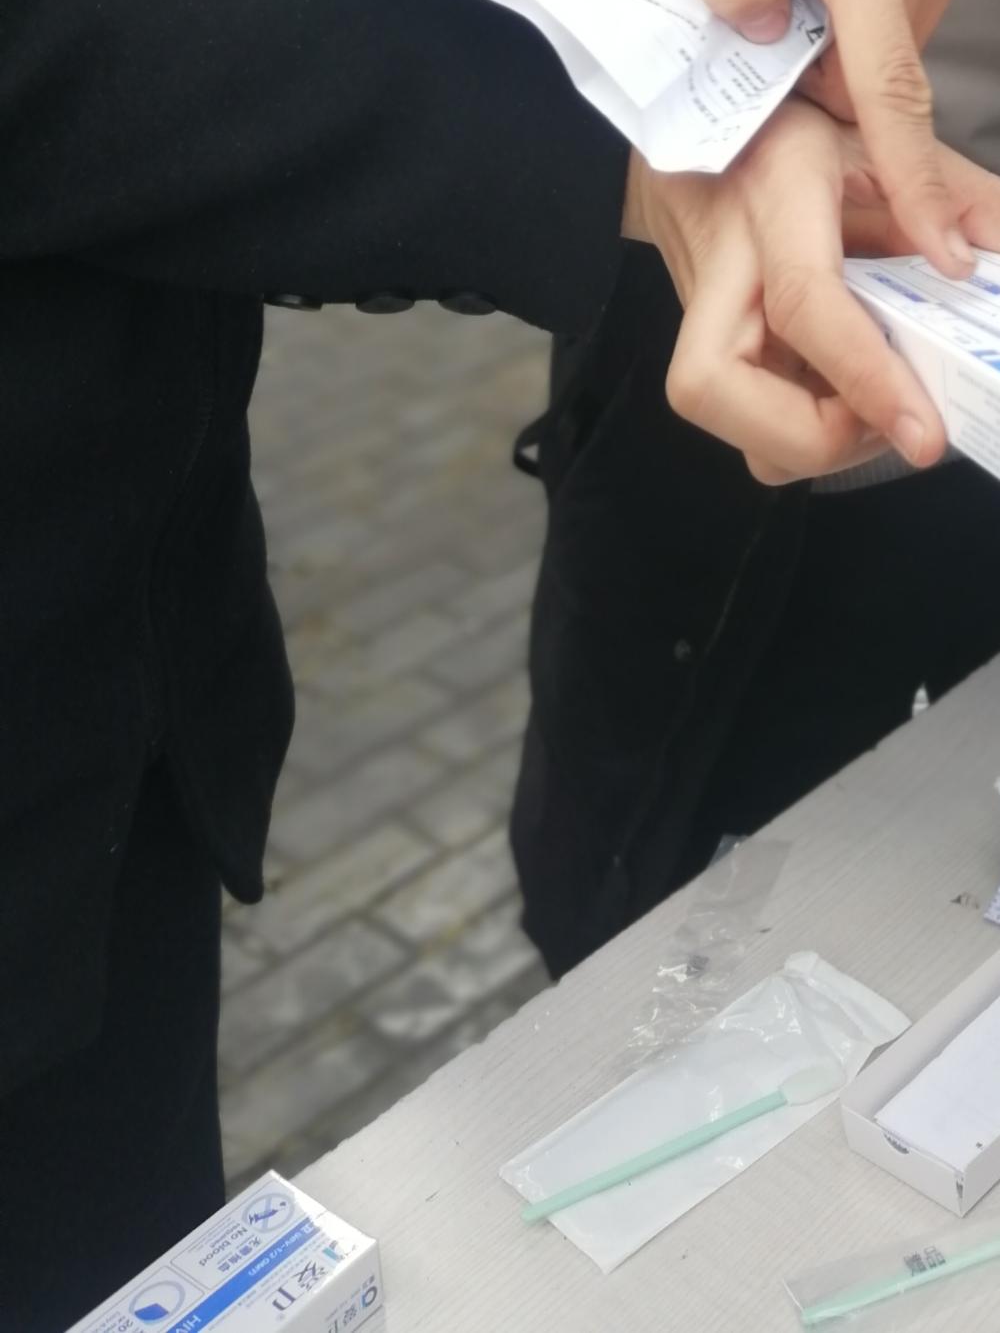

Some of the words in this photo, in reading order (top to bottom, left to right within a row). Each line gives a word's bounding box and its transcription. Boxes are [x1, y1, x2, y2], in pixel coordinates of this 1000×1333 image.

[231, 1226, 248, 1241] No
[200, 1240, 232, 1267] blood
[272, 1260, 328, 1311] 爱卫
